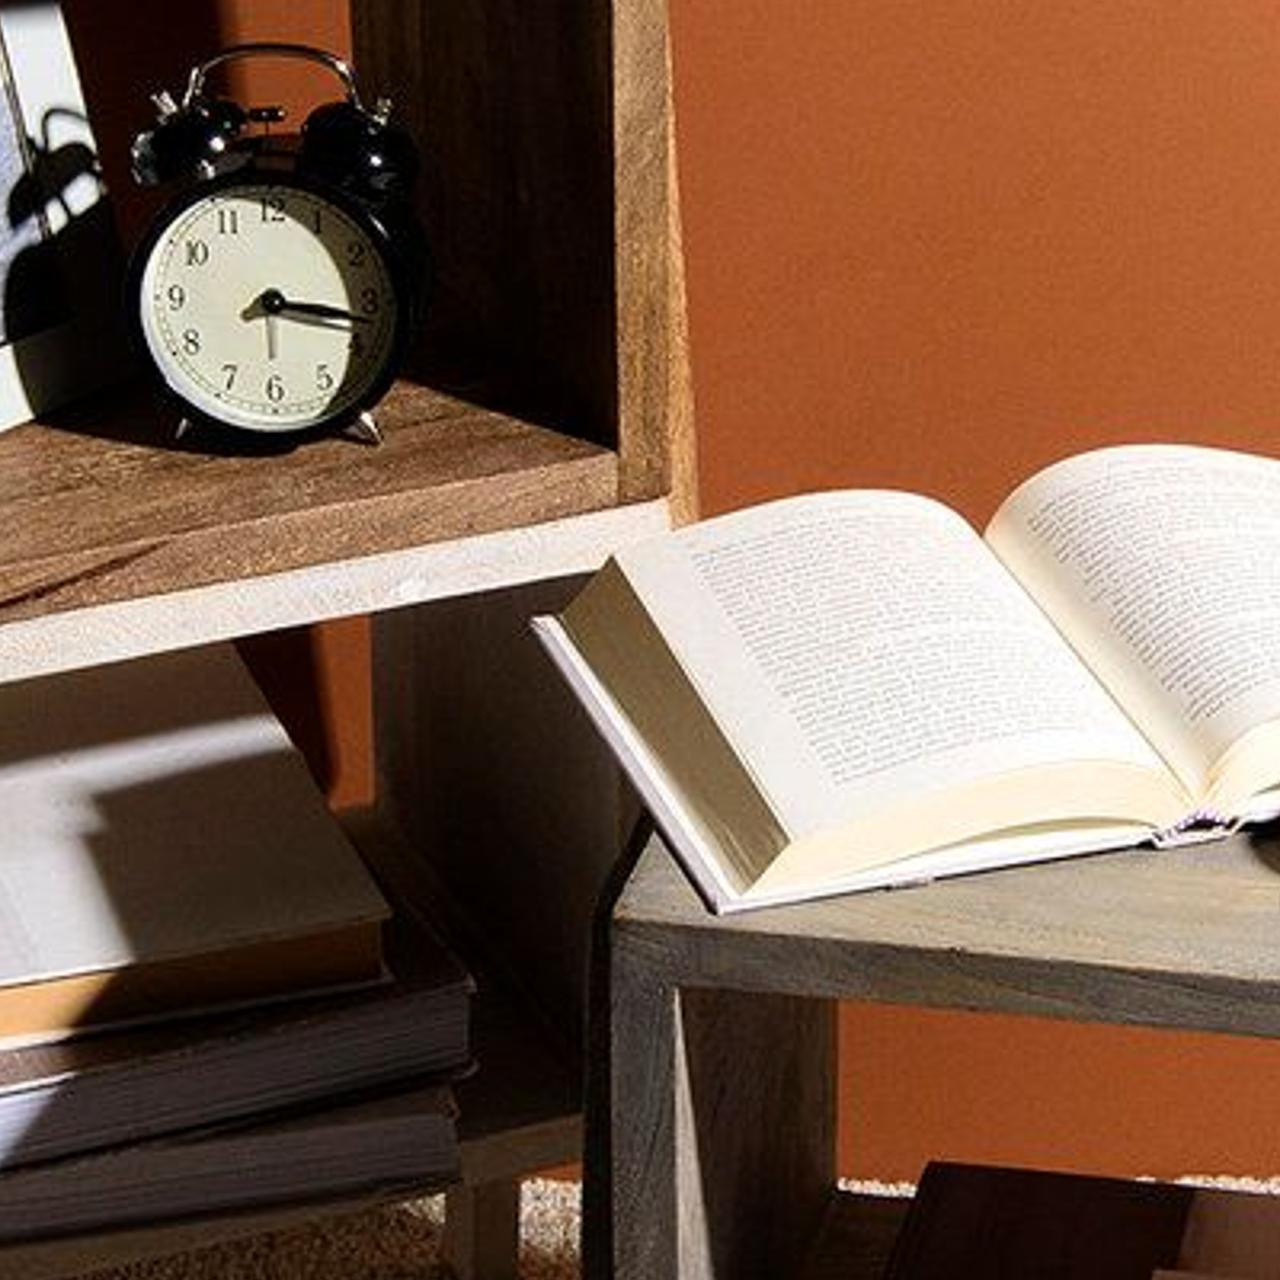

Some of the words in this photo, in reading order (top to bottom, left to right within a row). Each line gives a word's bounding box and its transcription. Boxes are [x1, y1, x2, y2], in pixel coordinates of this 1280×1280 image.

[217, 210, 239, 235] 11
[260, 198, 286, 223] 12
[313, 209, 322, 234] 1
[184, 241, 210, 267] 10
[347, 242, 365, 267] 2
[167, 285, 186, 311] 9
[360, 288, 379, 315] 3
[182, 329, 201, 356] 8
[221, 364, 238, 391] 7
[267, 375, 285, 403] 6
[316, 364, 334, 391] 5
